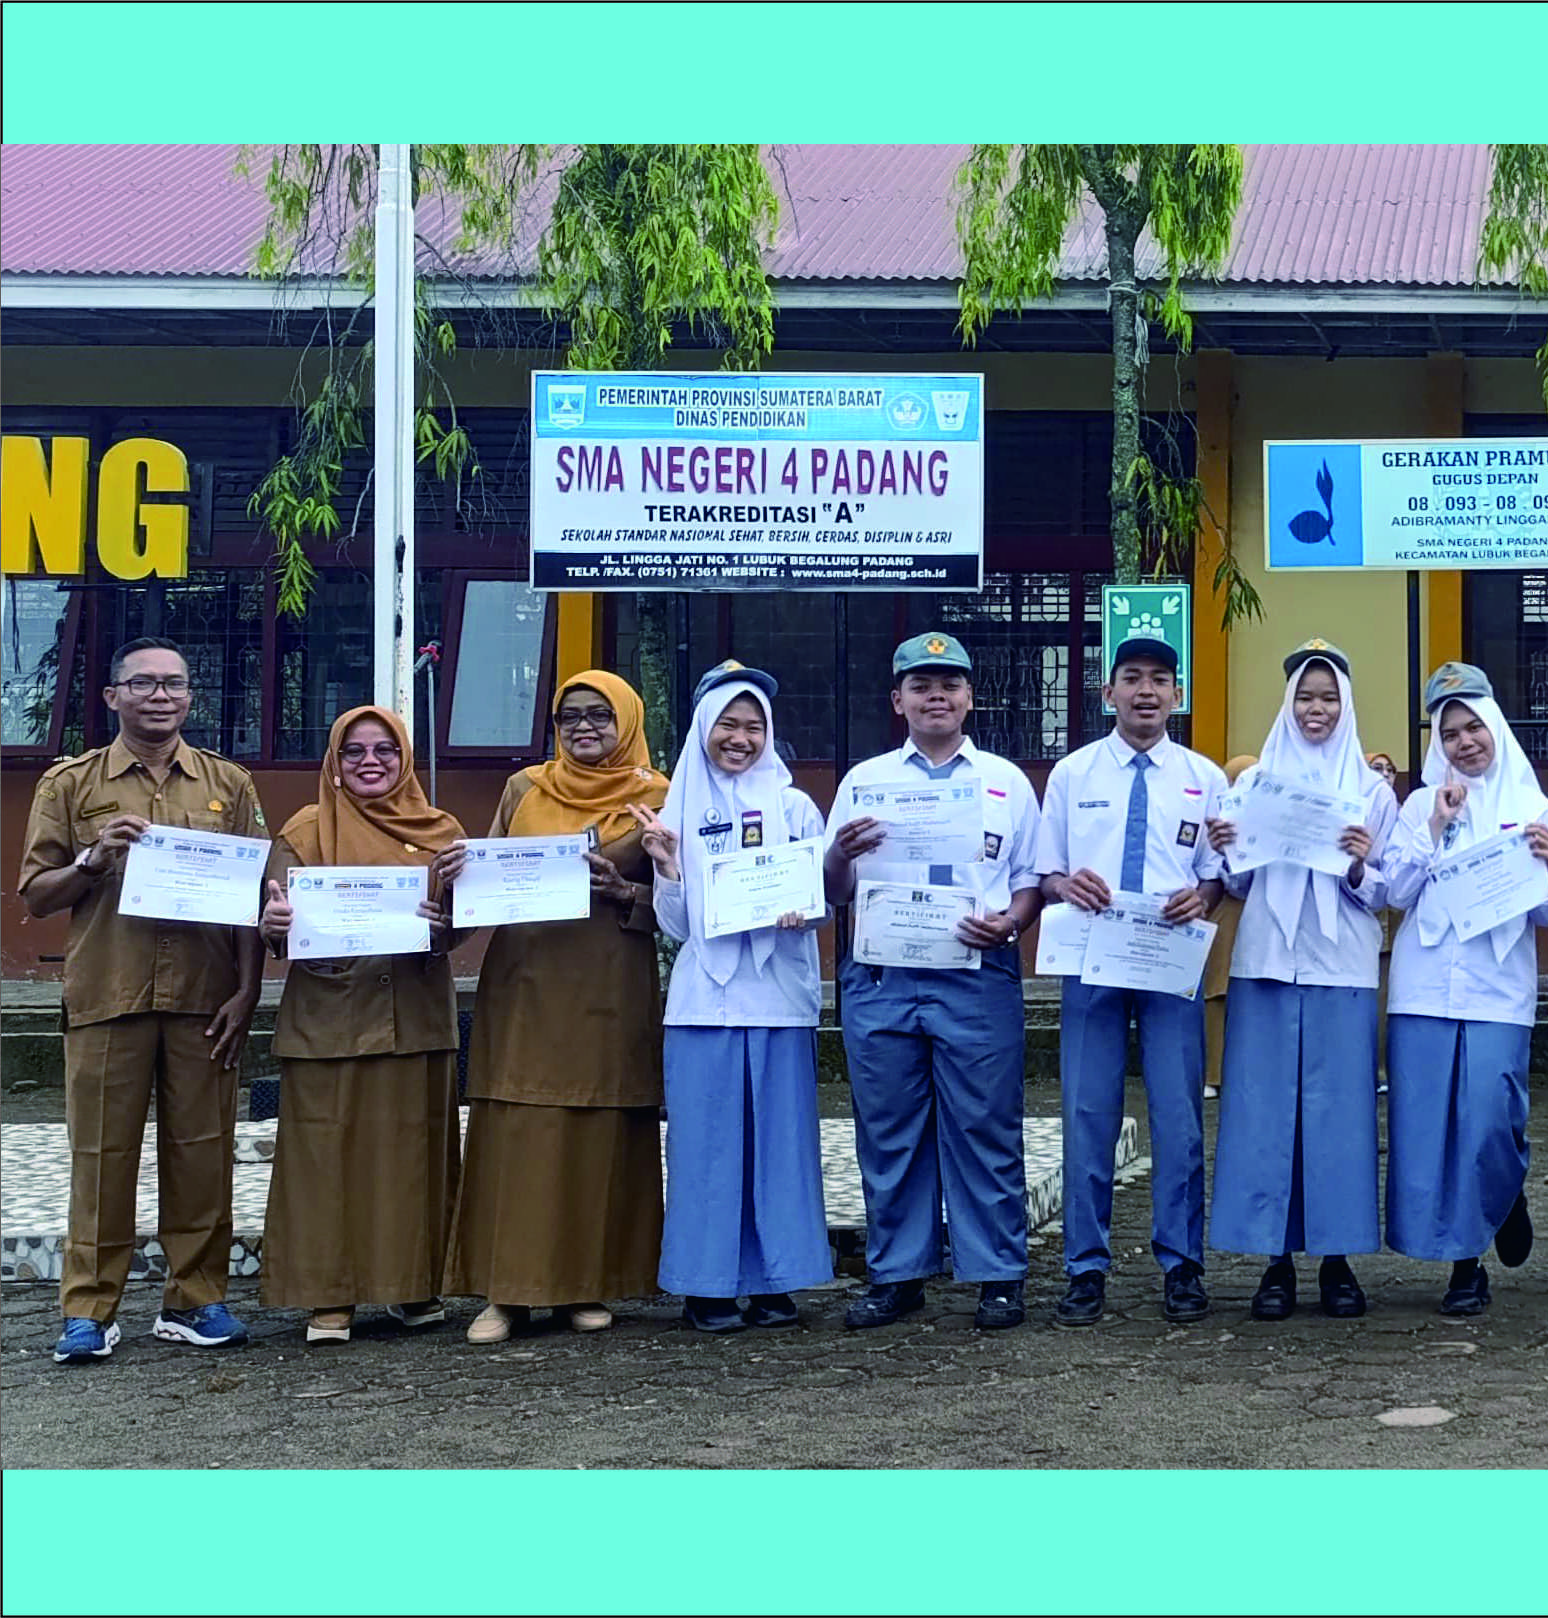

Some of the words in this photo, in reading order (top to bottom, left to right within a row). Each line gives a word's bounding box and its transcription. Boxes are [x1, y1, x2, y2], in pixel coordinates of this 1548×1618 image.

[599, 388, 688, 406] PEMERINTAH
[691, 389, 756, 407] PROVINSI
[759, 390, 834, 408] SUMATERA
[838, 390, 883, 408] BARAT
[675, 409, 718, 427] DINAS
[720, 410, 806, 428] PENDIDIKAN
[1381, 450, 1480, 468] GERAKAN
[556, 445, 625, 493] SMA
[641, 446, 768, 495] NEGERI
[781, 448, 799, 494] 4
[812, 449, 949, 497] PADANG
[1431, 474, 1484, 486] GUGUS
[1487, 473, 1539, 485] DEPAN
[1408, 496, 1429, 511] 08
[1445, 495, 1477, 511] 093
[1496, 495, 1517, 510] 08
[645, 505, 816, 523] TERAKREDITASI
[1391, 514, 1492, 527] ADIBRAMANTY
[561, 529, 612, 542] SEKOLAH
[614, 529, 668, 542] STANDAR
[669, 530, 725, 542] NASIONAL
[728, 530, 764, 543] SEHAT,
[768, 530, 811, 543] BERSIH,
[815, 531, 860, 544] CERDAS,
[864, 531, 912, 544] DISIPLIN
[915, 532, 922, 543] &
[926, 531, 952, 543] ASRI
[1417, 537, 1443, 547] SMA
[1447, 537, 1493, 547] NEGERI
[1495, 537, 1503, 546] 4
[600, 555, 619, 566] JL.
[622, 555, 672, 566] LINGGA
[675, 555, 703, 566] JATI
[706, 556, 728, 566] NO.
[733, 556, 739, 565] 1
[742, 556, 787, 566] LUBUK
[790, 556, 860, 566] BEGALUNG
[863, 556, 914, 566] PADANG
[1395, 549, 1468, 559] KECAMATAN
[1471, 549, 1512, 559] LUBUK
[566, 567, 600, 577] TELP.
[603, 567, 634, 577] /FAX.
[638, 567, 677, 578] (0751)
[721, 567, 778, 577] WEBSITE
[791, 569, 947, 580] www.sma4-padang.sch.id
